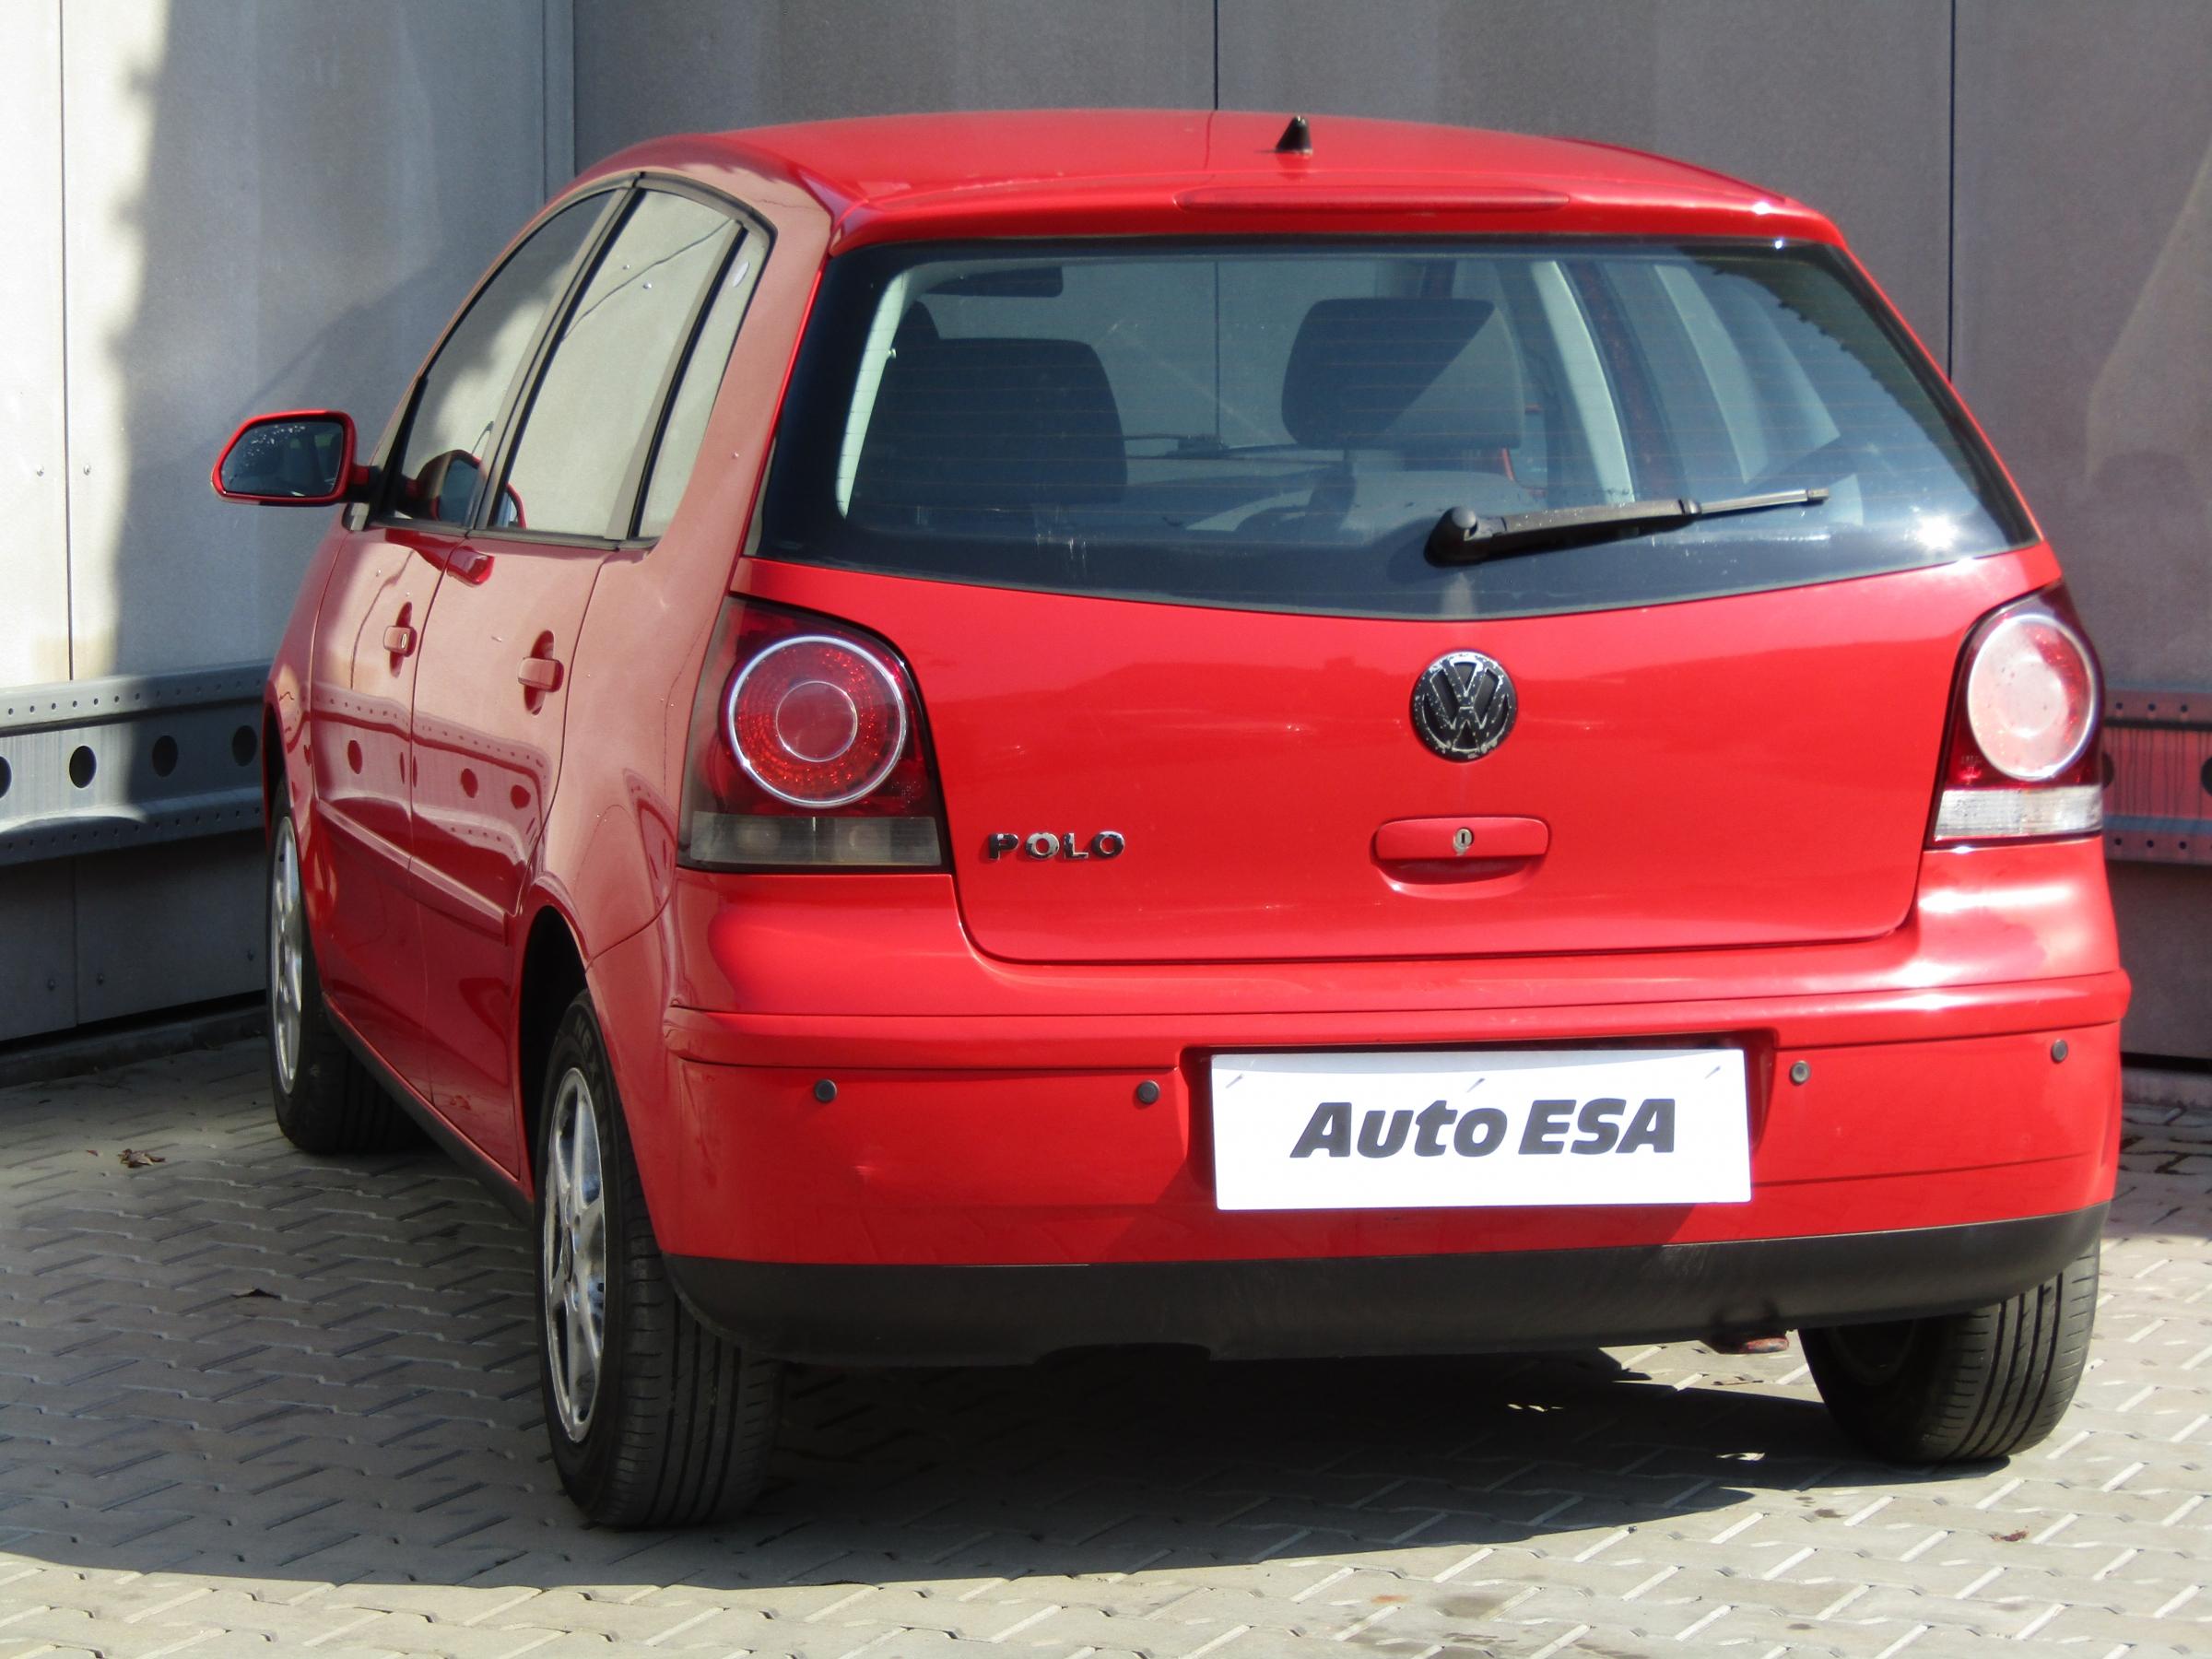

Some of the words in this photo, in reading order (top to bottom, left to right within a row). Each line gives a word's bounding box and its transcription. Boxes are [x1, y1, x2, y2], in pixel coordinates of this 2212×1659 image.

[1415, 653, 1514, 759] VW
[988, 830, 1125, 861] POLO
[1289, 1100, 1507, 1159] Auto
[1518, 1098, 1676, 1155] ESA
